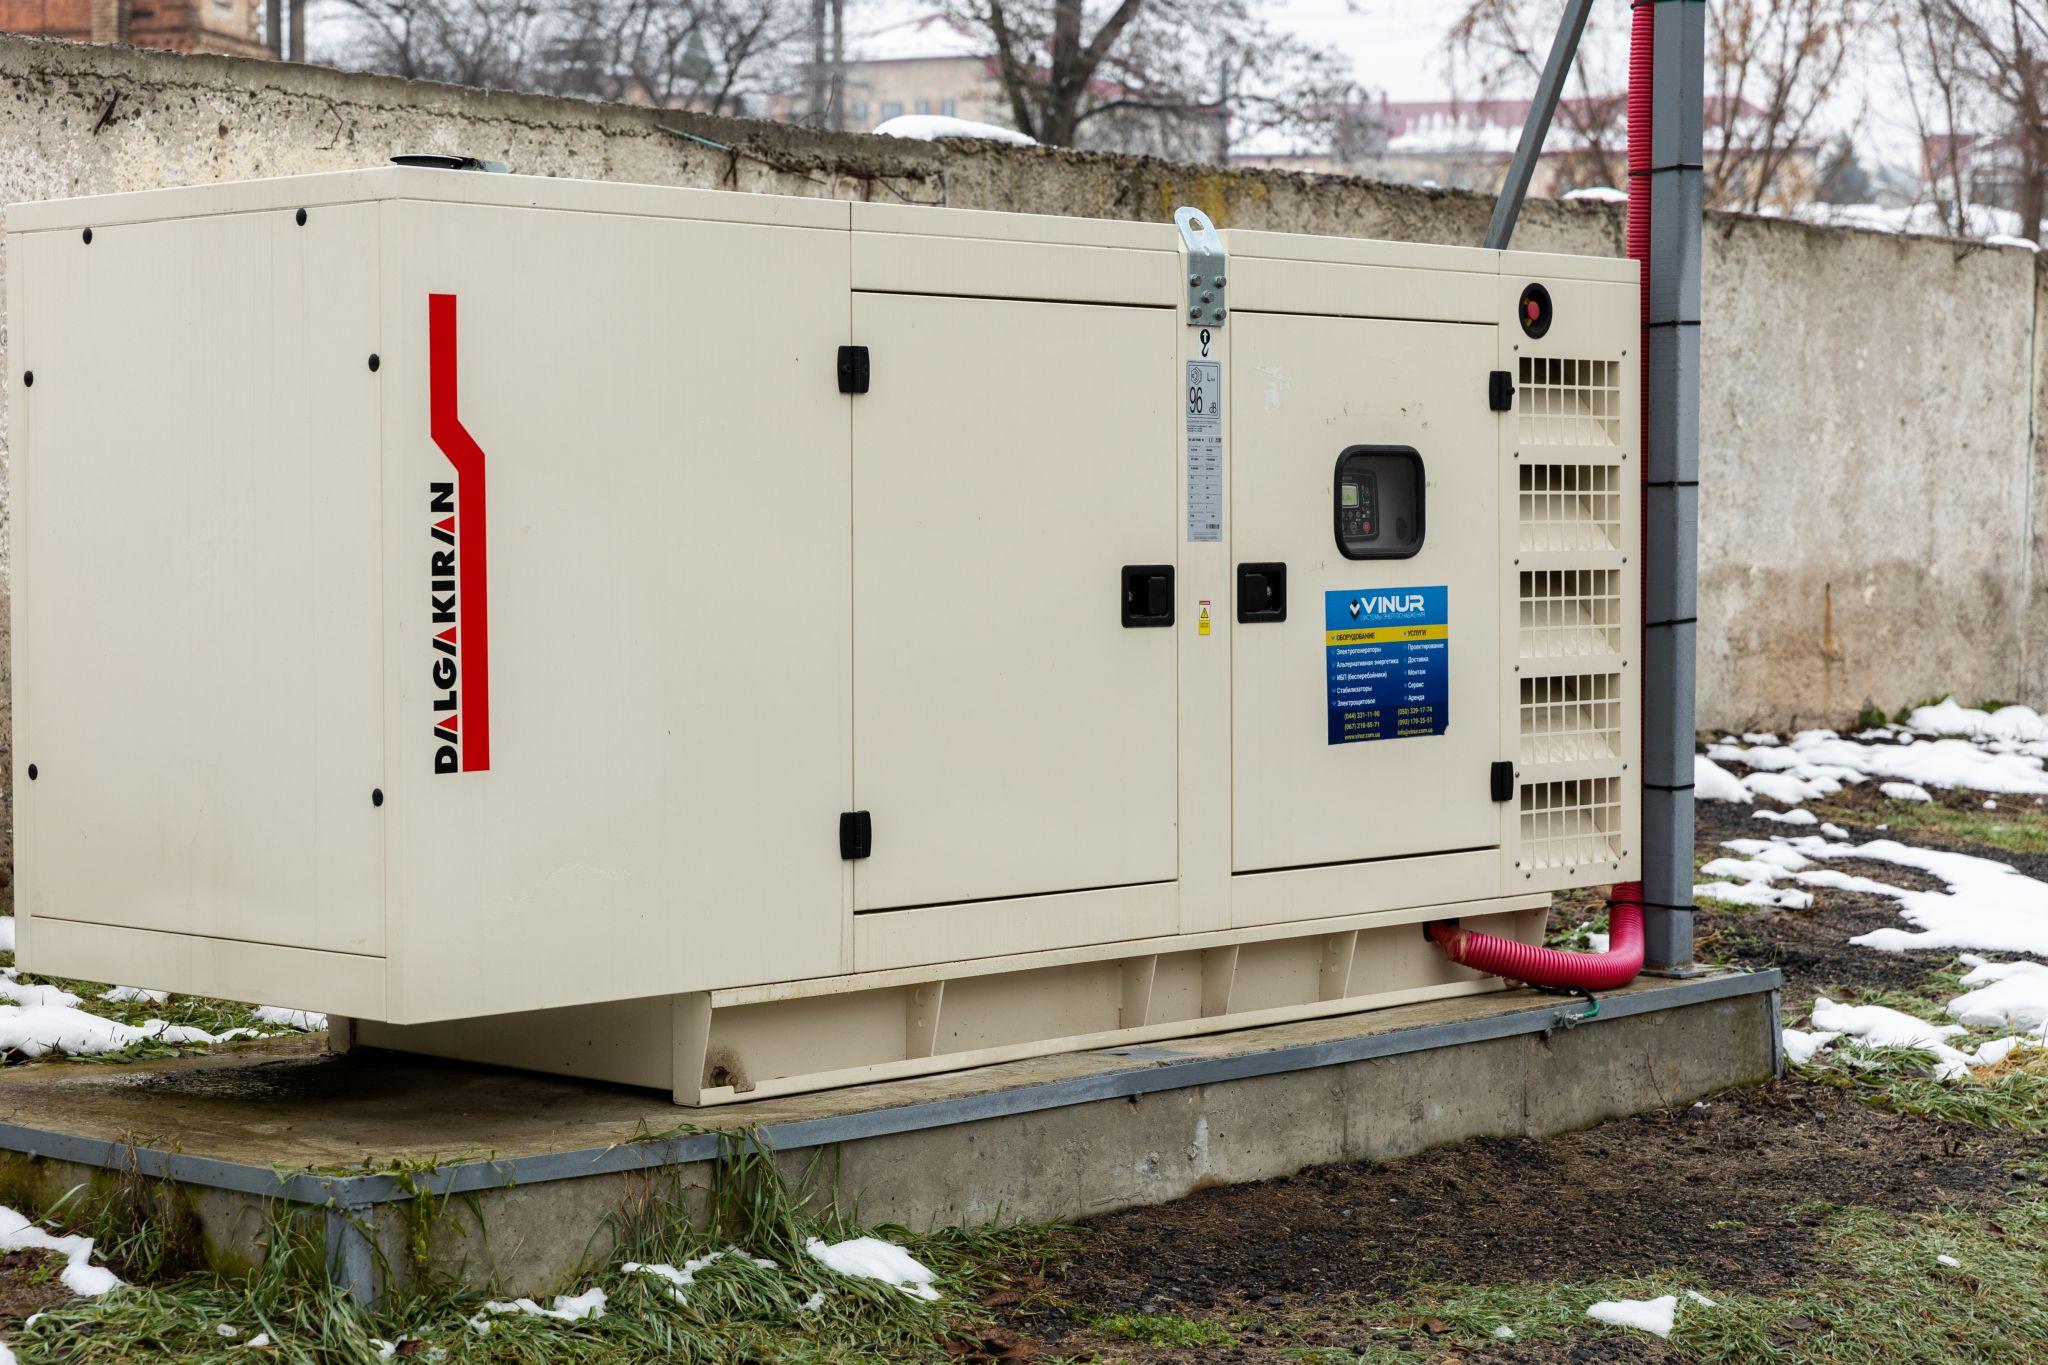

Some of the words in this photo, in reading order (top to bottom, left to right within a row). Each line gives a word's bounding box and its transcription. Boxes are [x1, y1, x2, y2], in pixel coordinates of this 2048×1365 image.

[1189, 386, 1203, 414] 96
[1209, 402, 1217, 414] dB
[1360, 595, 1425, 614] VINUR
[430, 482, 458, 774] DALGAKIRAN
[1337, 632, 1376, 642] ОБОРУДОВАНИЕ
[1407, 629, 1427, 637] УСЛУГИ
[1336, 647, 1382, 656] Электрогенераторы
[1407, 643, 1444, 651] Проектирование
[1336, 660, 1374, 669] Альтернативная
[1374, 658, 1399, 667] энергетика
[1407, 656, 1429, 665] Доставка
[1347, 670, 1388, 681] (бесперебойники)
[1407, 681, 1425, 689] Сервис
[1336, 686, 1373, 694] Стабилизаторы
[1407, 694, 1425, 702] Аренда
